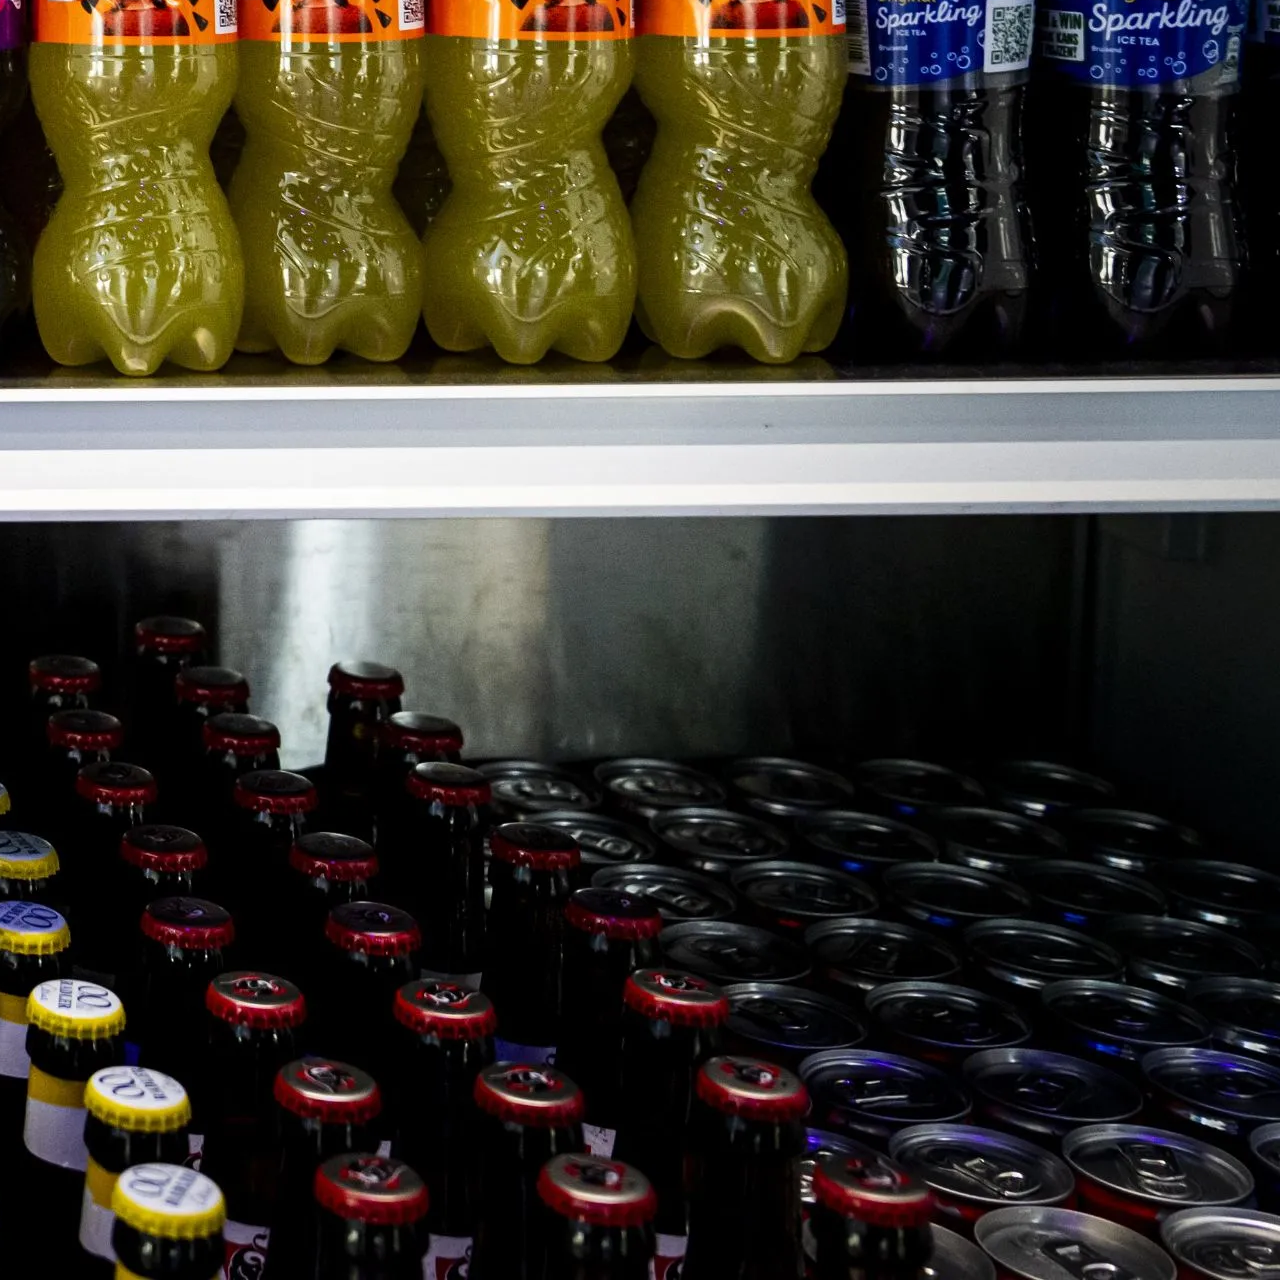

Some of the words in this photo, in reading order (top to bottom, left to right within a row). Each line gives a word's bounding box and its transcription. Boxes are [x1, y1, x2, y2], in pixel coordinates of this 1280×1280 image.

[876, 1, 983, 37] Sparkling
[1058, 12, 1082, 30] WIN
[1087, 0, 1230, 41] Sparkling
[895, 29, 910, 37] ICE
[910, 28, 926, 37] TEA
[1117, 36, 1137, 46] ICE
[1138, 36, 1160, 46] TEA
